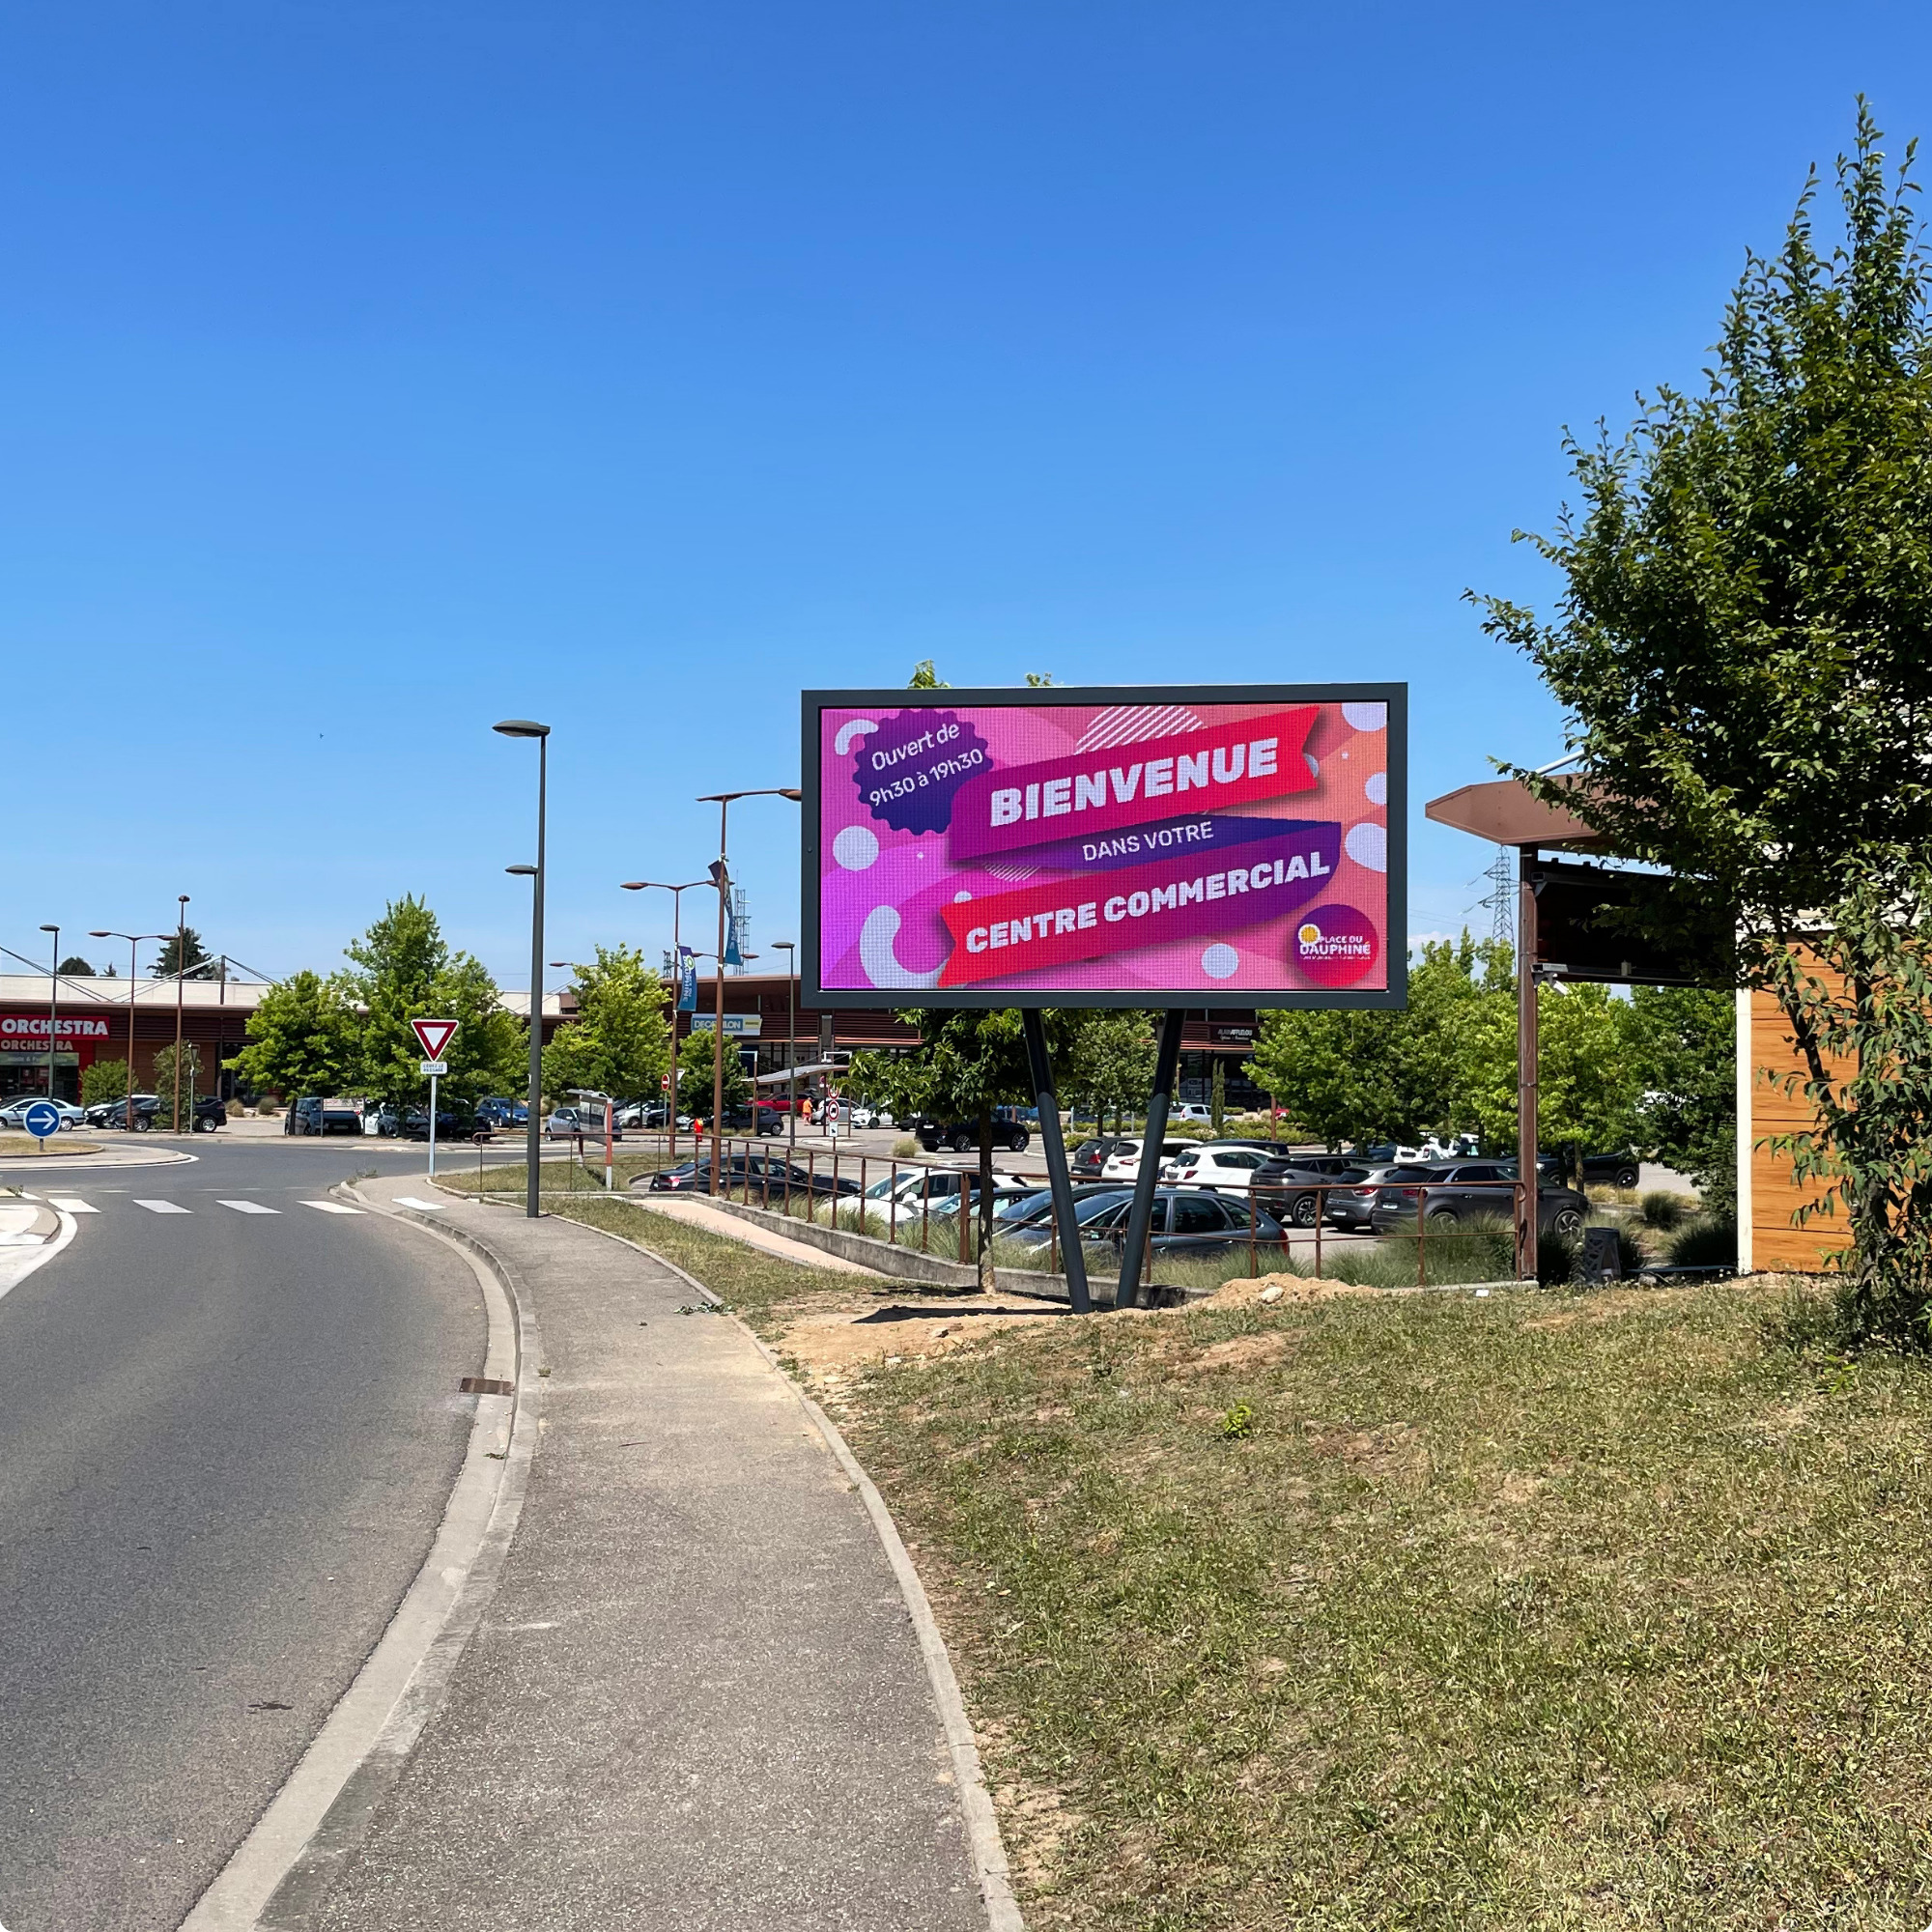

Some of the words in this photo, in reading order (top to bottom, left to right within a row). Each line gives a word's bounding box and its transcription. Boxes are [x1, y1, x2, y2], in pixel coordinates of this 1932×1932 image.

[871, 730, 935, 771] Ouvert
[936, 723, 960, 745] de
[869, 777, 916, 807] 9h30
[916, 772, 929, 787] à
[929, 749, 983, 781] 19h30
[990, 737, 1279, 828] BIENVENUE
[1082, 836, 1141, 862] DANS
[1143, 821, 1214, 851] VOTRE
[965, 901, 1097, 954] CENTRE
[1104, 851, 1331, 923] COMMERCIAL
[1299, 941, 1372, 955] DAUPHINÉ
[1319, 935, 1348, 944] PLACE
[1349, 935, 1363, 944] DU
[0, 1039, 73, 1051] ORCHESRA
[1, 1018, 109, 1035] ORCHESTRA
